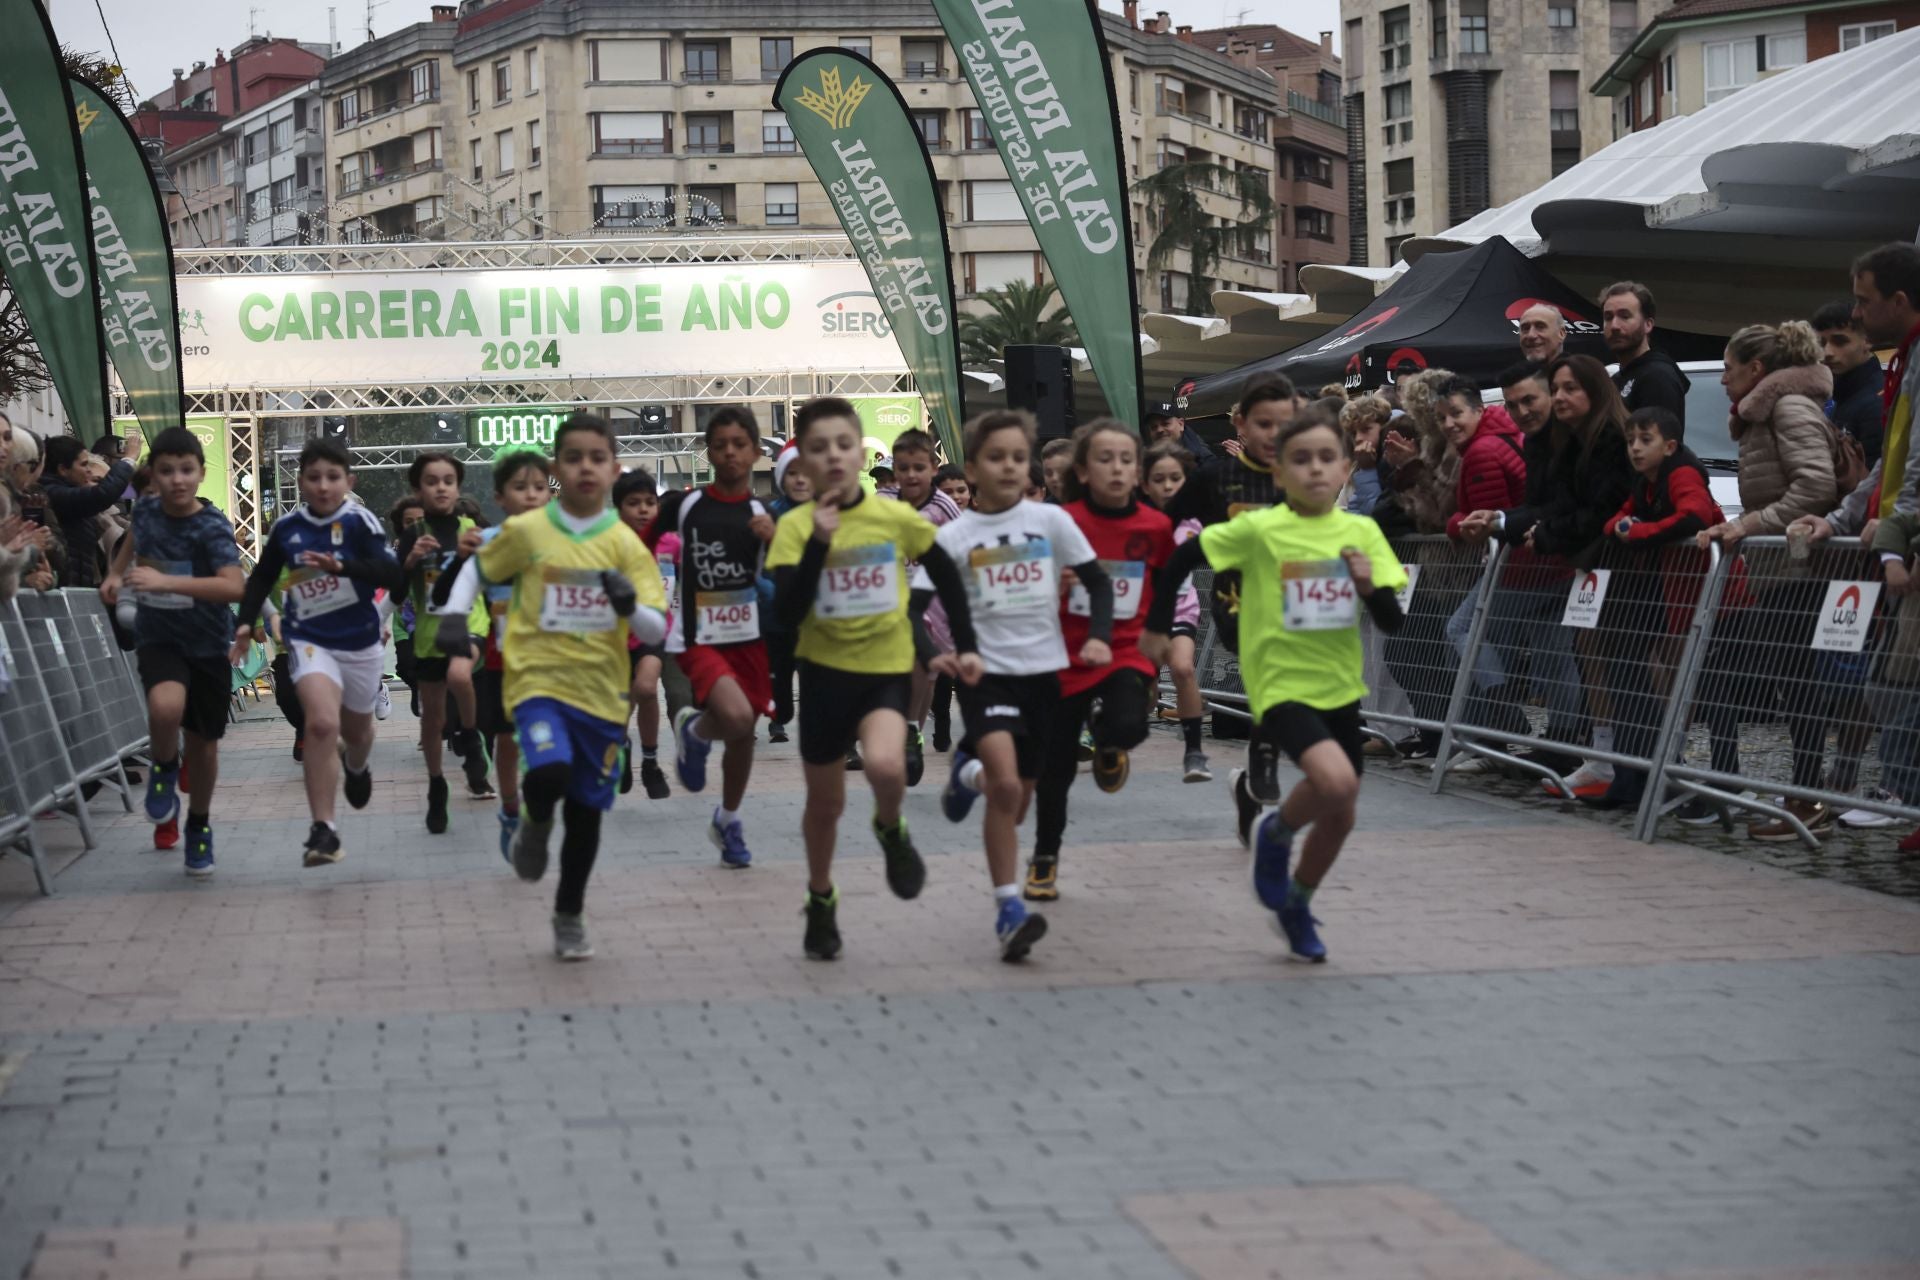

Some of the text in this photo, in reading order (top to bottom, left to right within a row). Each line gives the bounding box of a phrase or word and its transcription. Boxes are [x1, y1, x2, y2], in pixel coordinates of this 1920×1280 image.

[238, 274, 790, 343] CARRERA FIN DE AÑO
[481, 339, 561, 371] 2024
[690, 528, 726, 558] be
[826, 565, 886, 593] 1366
[985, 561, 1043, 588] 1405
[1294, 579, 1353, 603] 1454
[705, 604, 752, 625] 1408
